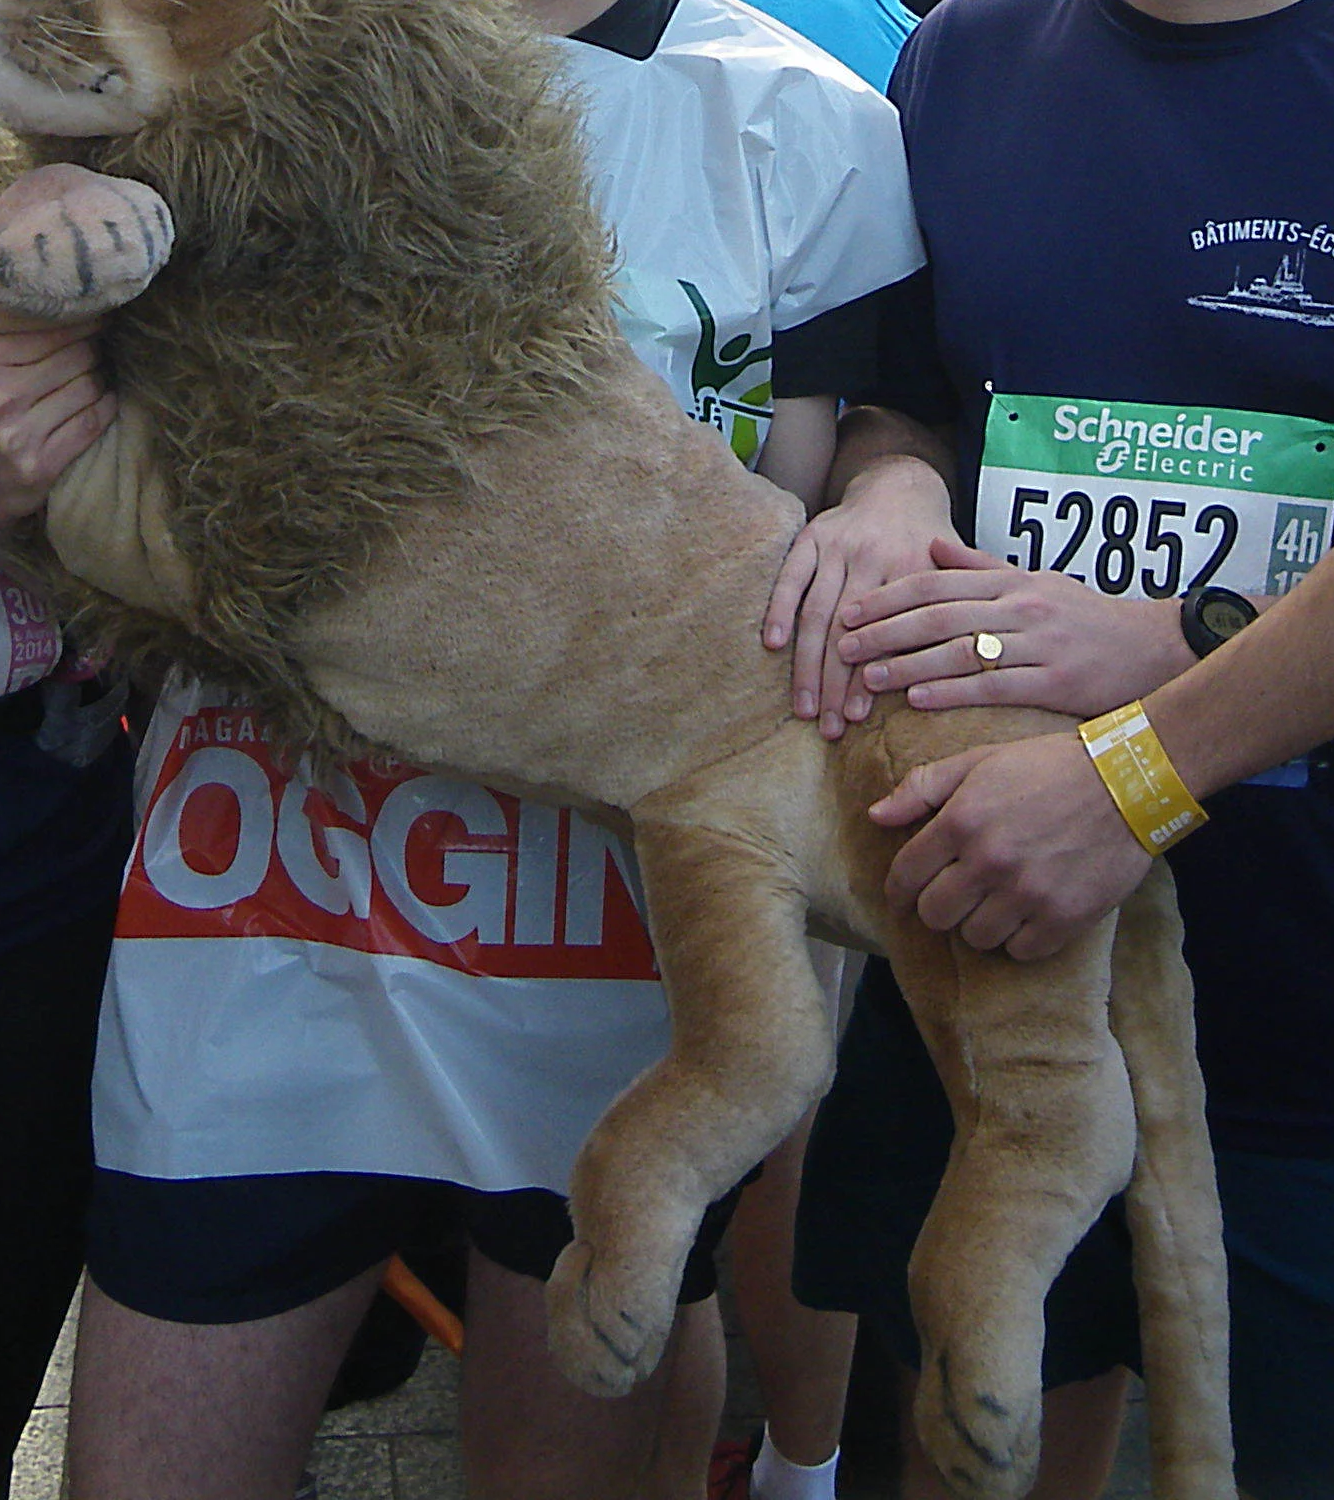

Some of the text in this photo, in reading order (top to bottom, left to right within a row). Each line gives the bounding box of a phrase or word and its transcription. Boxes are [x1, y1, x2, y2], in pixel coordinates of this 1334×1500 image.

[1051, 403, 1264, 457] Schneider
[1133, 448, 1255, 483] Electric
[1007, 486, 1320, 599] 52852 4h
[14, 640, 54, 662] 2014
